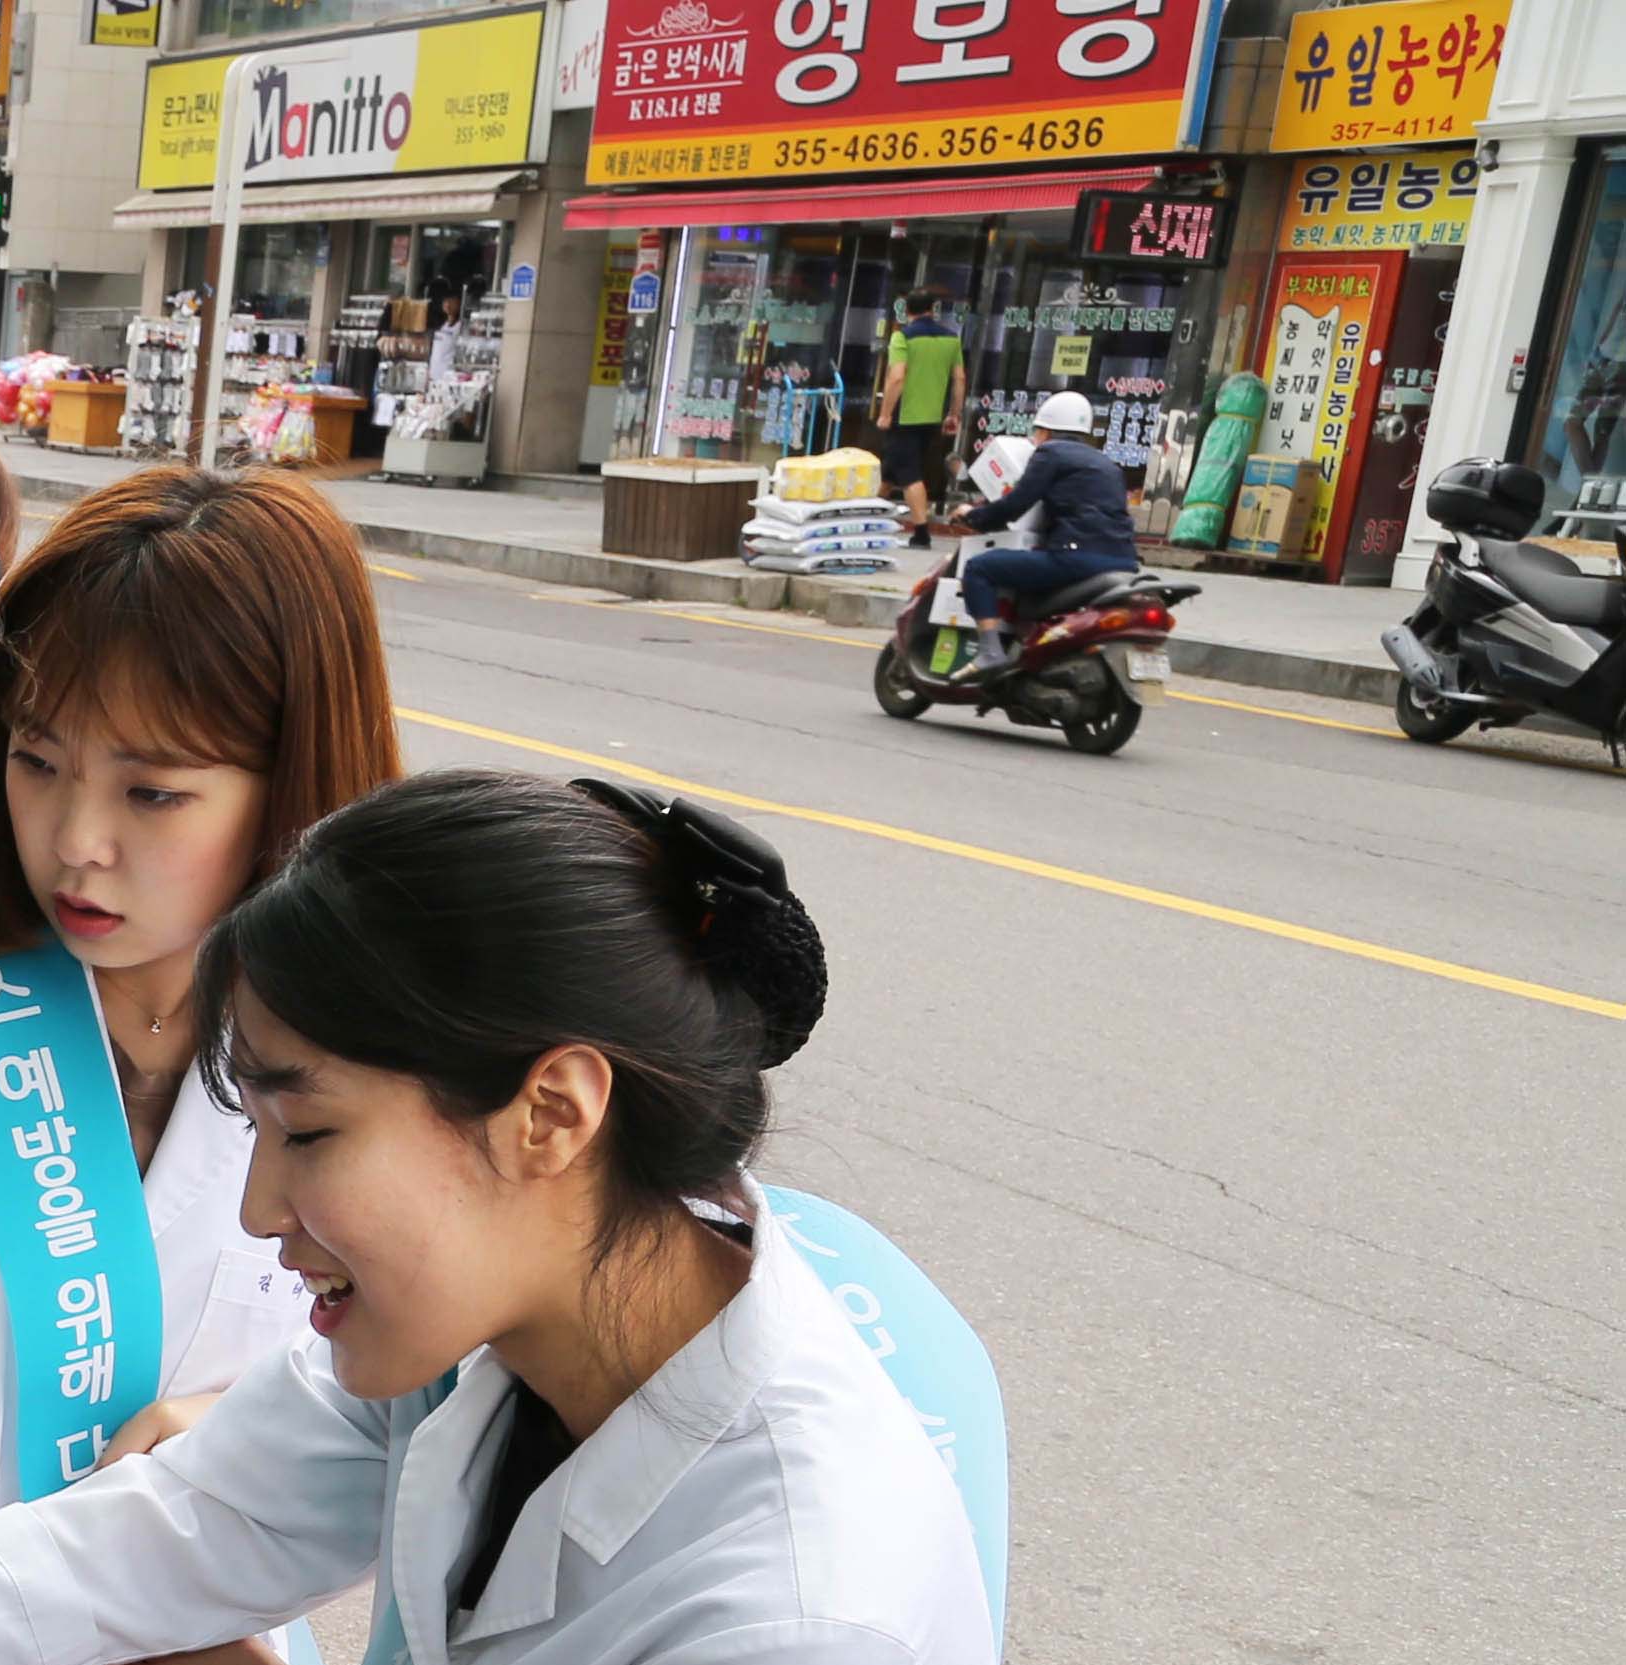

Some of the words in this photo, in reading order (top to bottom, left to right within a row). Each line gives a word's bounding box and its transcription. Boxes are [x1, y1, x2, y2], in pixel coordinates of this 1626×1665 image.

[245, 66, 412, 171] Manitto
[693, 92, 722, 116] 전문
[1331, 116, 1453, 141] 357-4114
[56, 1272, 114, 1405] 위해
